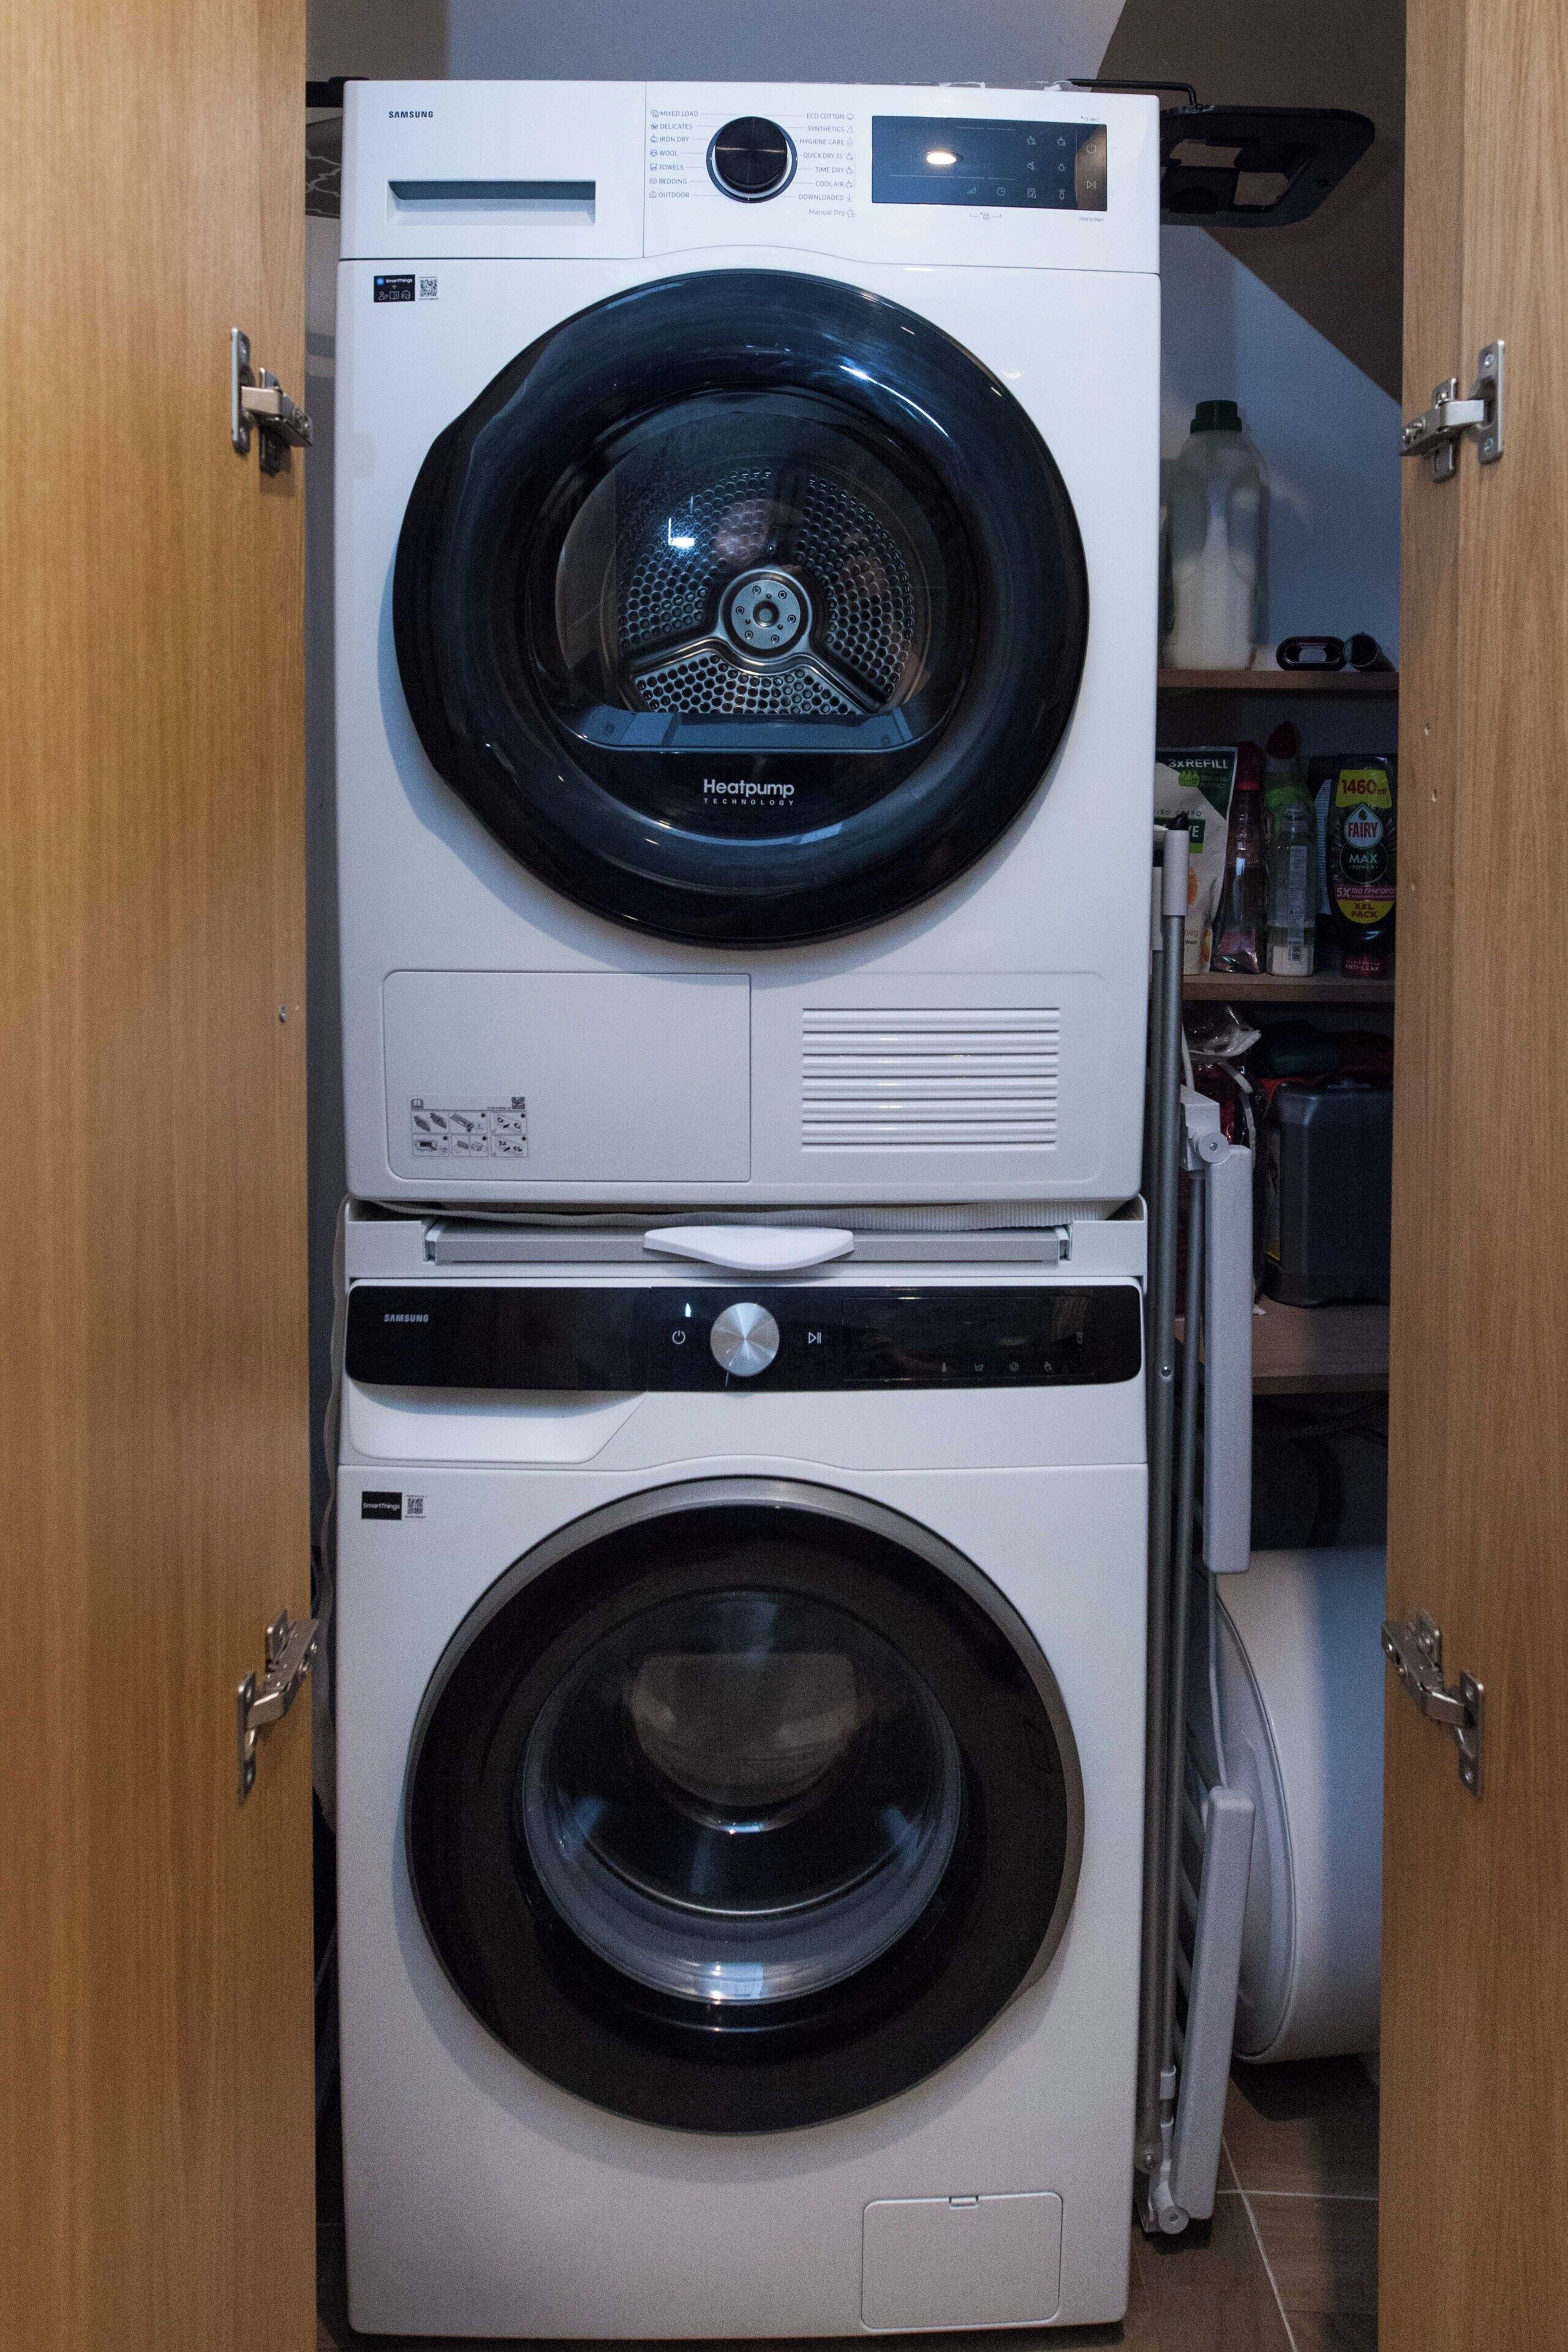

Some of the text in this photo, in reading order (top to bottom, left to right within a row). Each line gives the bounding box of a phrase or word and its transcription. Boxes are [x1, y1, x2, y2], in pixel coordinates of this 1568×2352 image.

[703, 778, 794, 798] Heatpump
[1348, 822, 1378, 838] FAIRY
[1349, 853, 1378, 864] MAX
[383, 1314, 429, 1322] SAMSUNG
[363, 1502, 401, 1511] SmartThings
